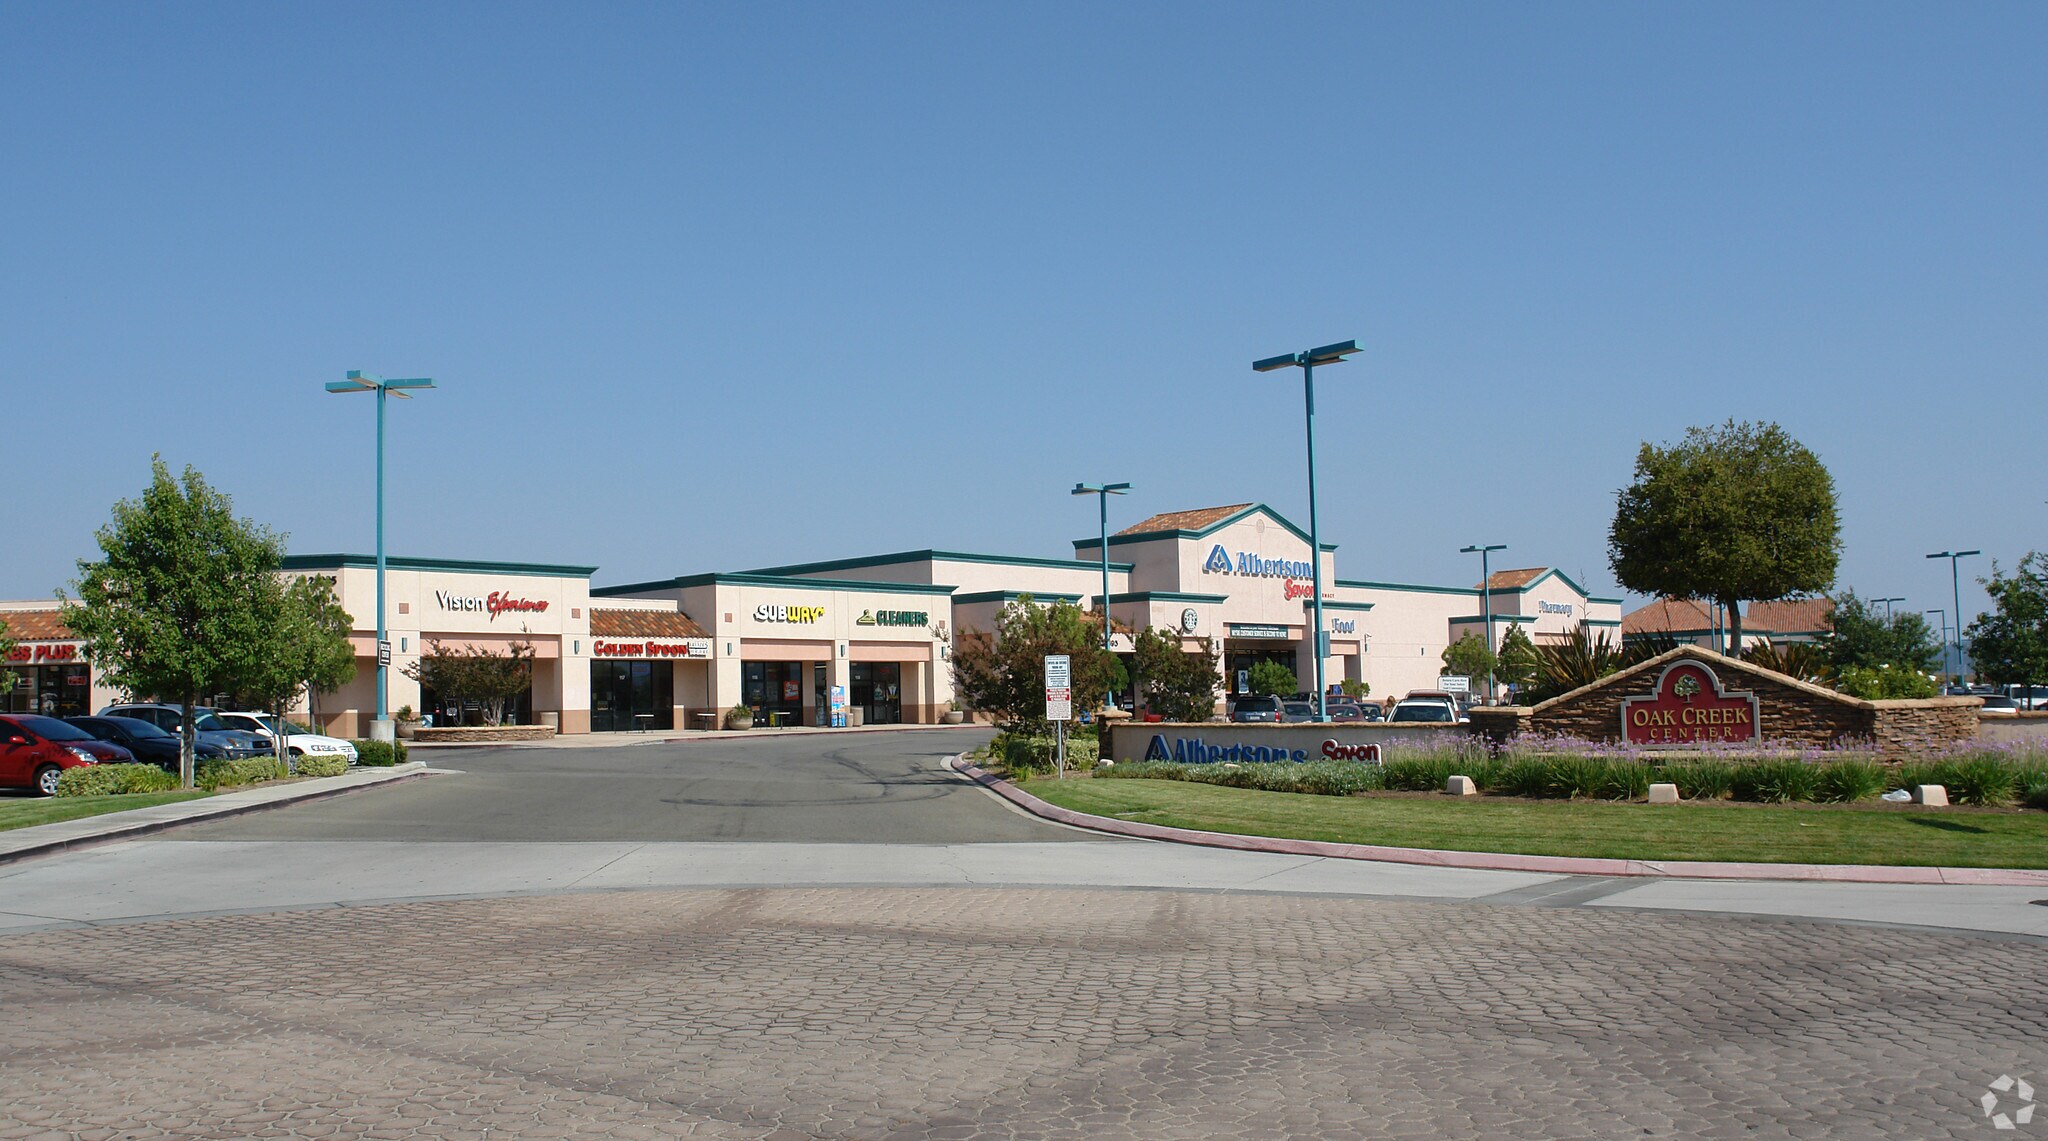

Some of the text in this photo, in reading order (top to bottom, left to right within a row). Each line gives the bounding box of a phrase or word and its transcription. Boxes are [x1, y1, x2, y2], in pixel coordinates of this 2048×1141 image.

[1236, 551, 1314, 579] Albertson
[487, 590, 549, 623] Experience
[753, 604, 825, 623] SUBWAY
[1538, 600, 1572, 617] Pharmacy
[876, 610, 928, 627] CLEANERS
[1332, 617, 1355, 633] Food
[35, 644, 77, 661] PLUS
[594, 640, 644, 657] GOLDEN
[646, 641, 687, 657] SPOON
[1633, 707, 1750, 726] OAK CREEK
[1650, 726, 1733, 739] CENTER
[1174, 738, 1310, 763] Albertsons
